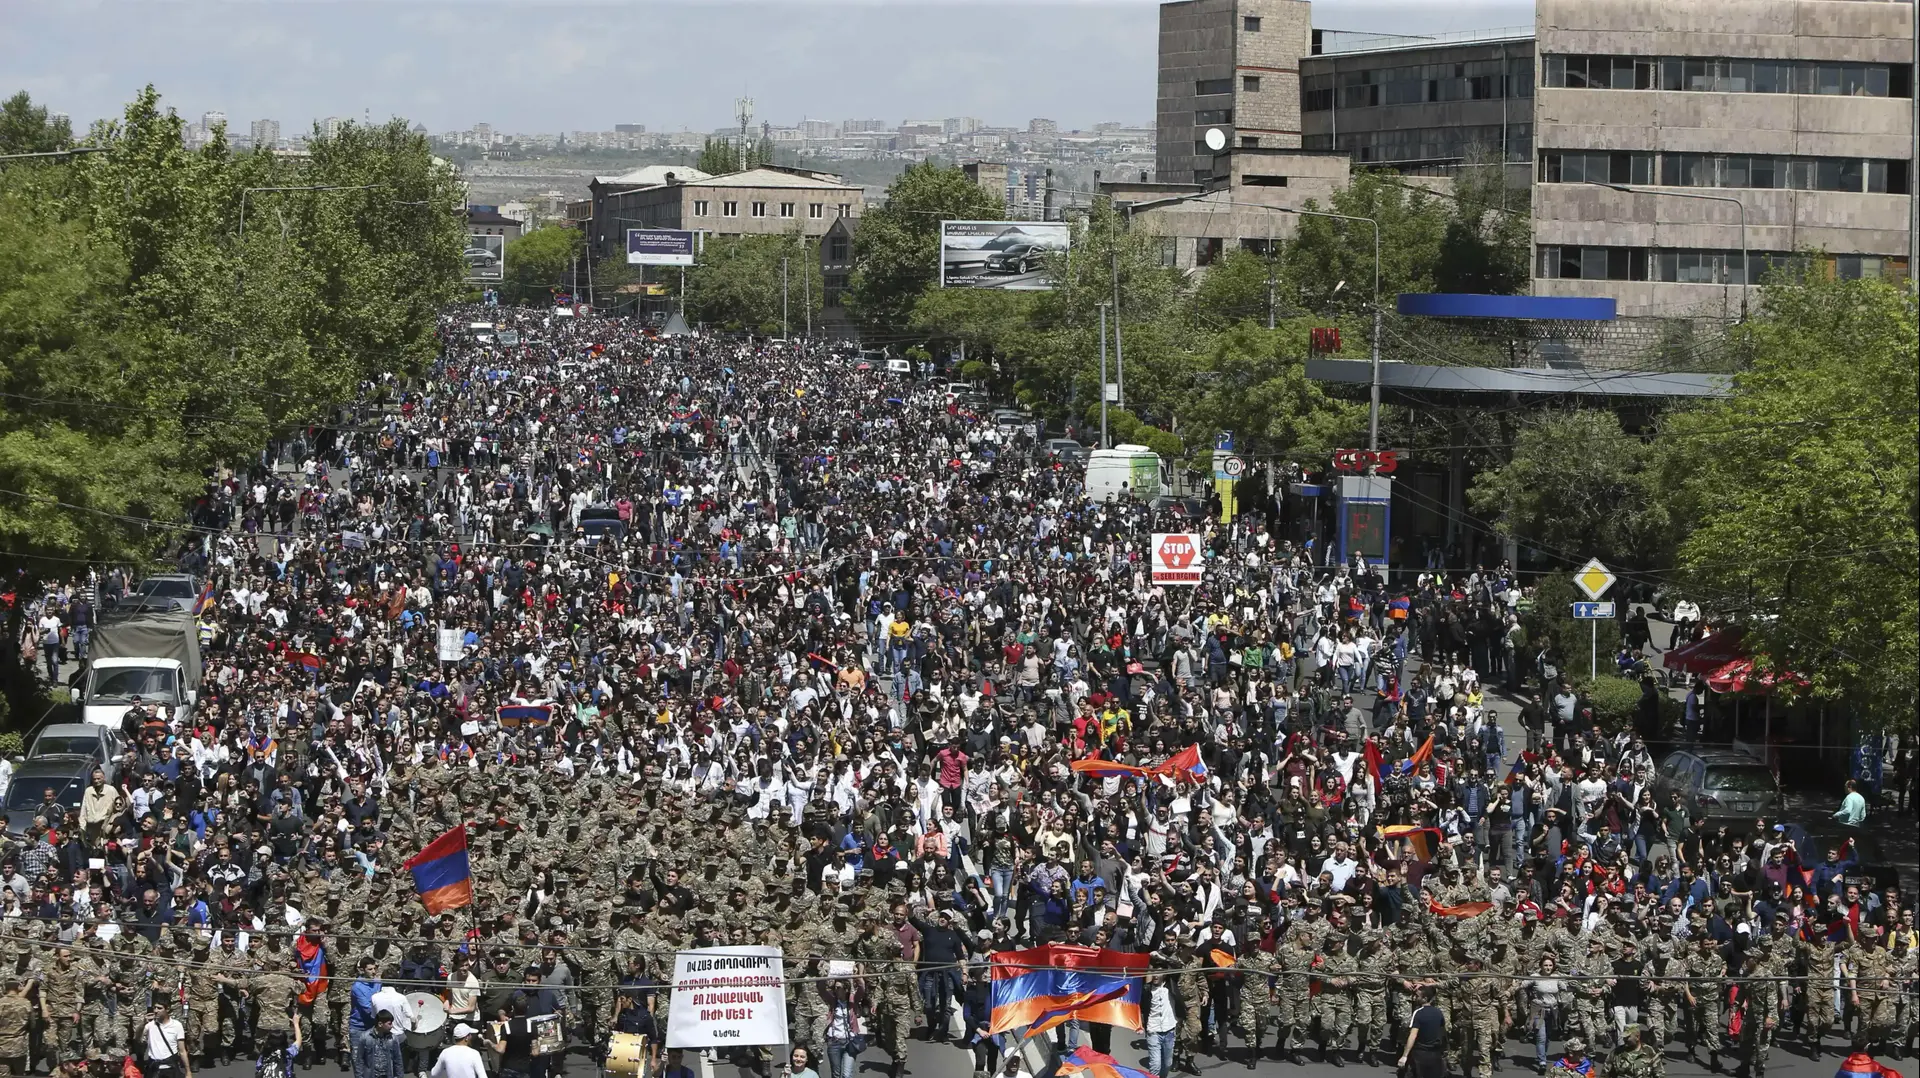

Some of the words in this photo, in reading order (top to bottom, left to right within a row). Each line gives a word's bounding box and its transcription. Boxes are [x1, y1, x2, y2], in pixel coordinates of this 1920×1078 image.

[1228, 462, 1239, 471] 70
[1163, 542, 1191, 555] STOP
[1176, 572, 1200, 581] REGIME
[687, 961, 697, 973] ՈՎ
[697, 959, 713, 971] ՀԱՅ
[678, 980, 688, 992] ՔՈ
[689, 977, 710, 991] ՄԻԱԿ
[693, 993, 704, 1006] ՔՈ
[705, 991, 764, 1005] ՀԱՎԱՔԱԿԱՆ
[700, 1009, 724, 1021] ՈՒԺԻ
[725, 1008, 746, 1020] ՄԵՋ
[747, 1008, 753, 1020] Է
